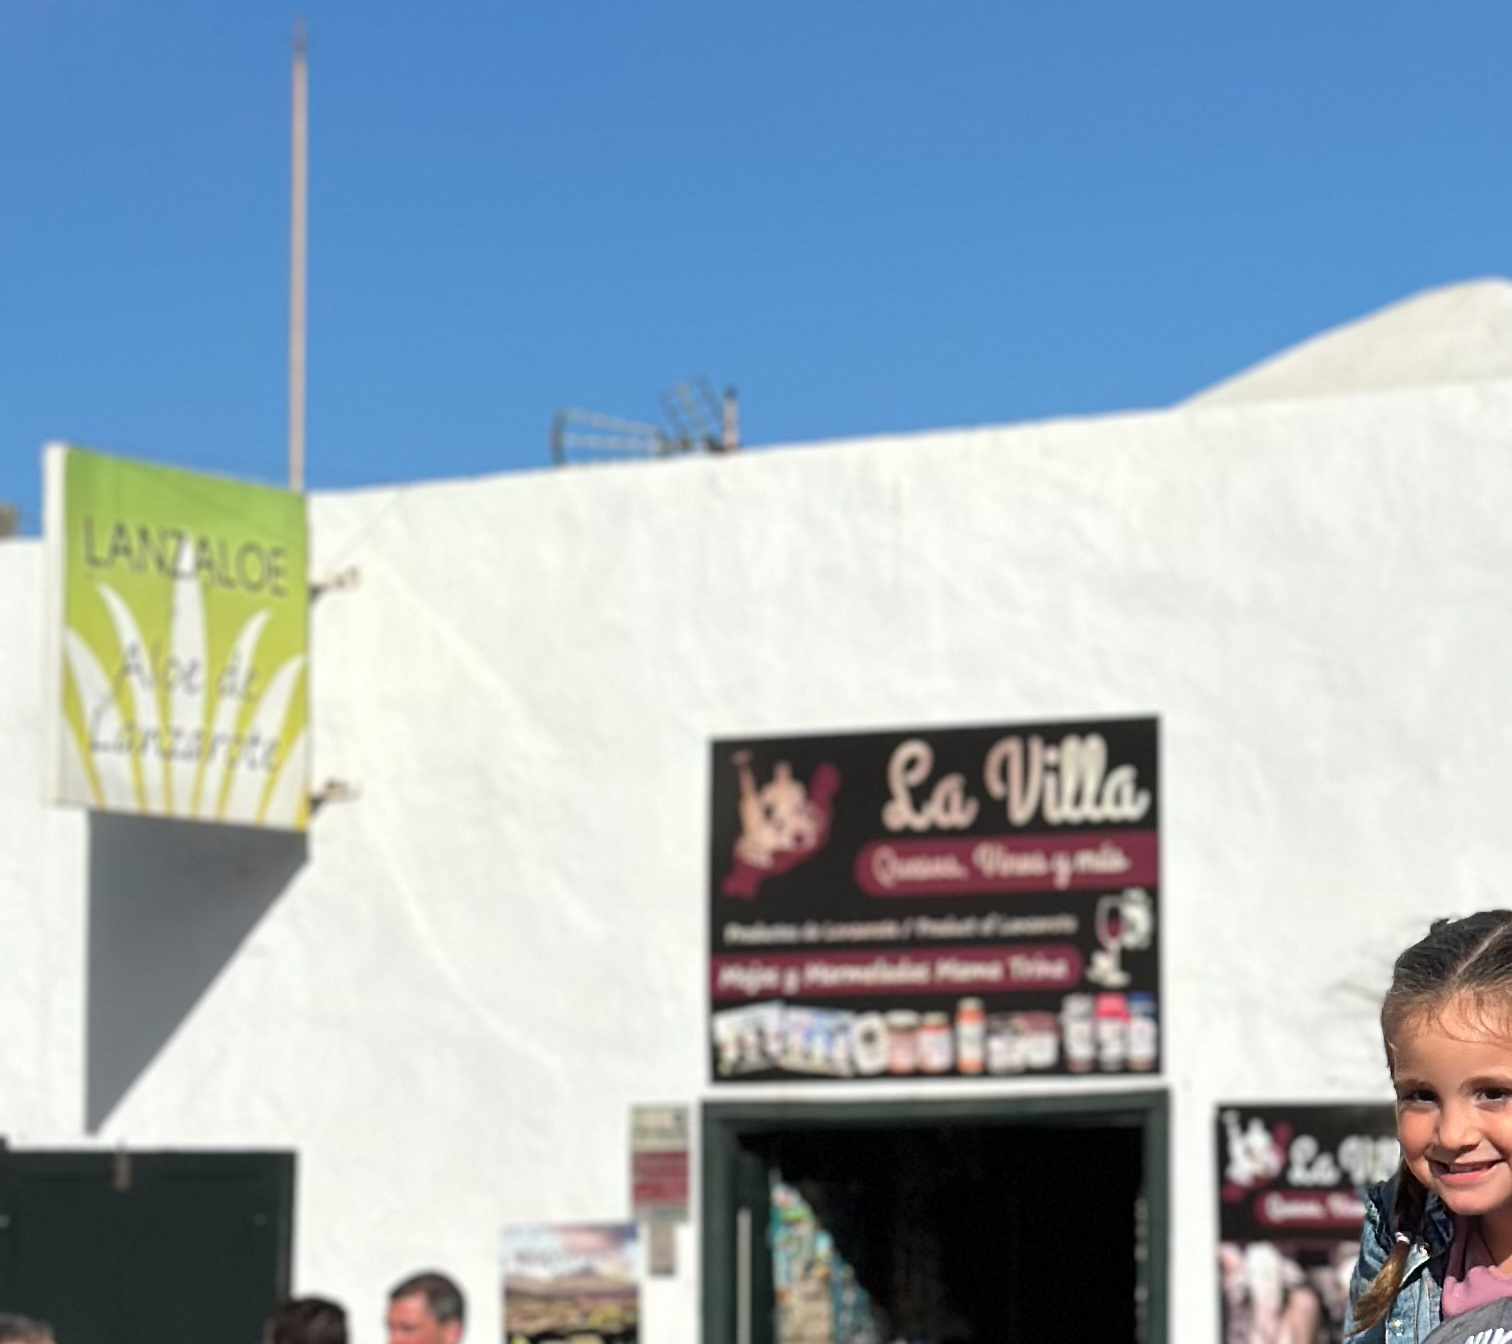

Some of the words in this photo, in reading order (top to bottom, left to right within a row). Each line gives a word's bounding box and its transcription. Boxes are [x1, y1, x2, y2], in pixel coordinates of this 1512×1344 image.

[83, 516, 288, 599] LANZALOE
[881, 739, 979, 831] La
[983, 733, 1151, 826] Villa
